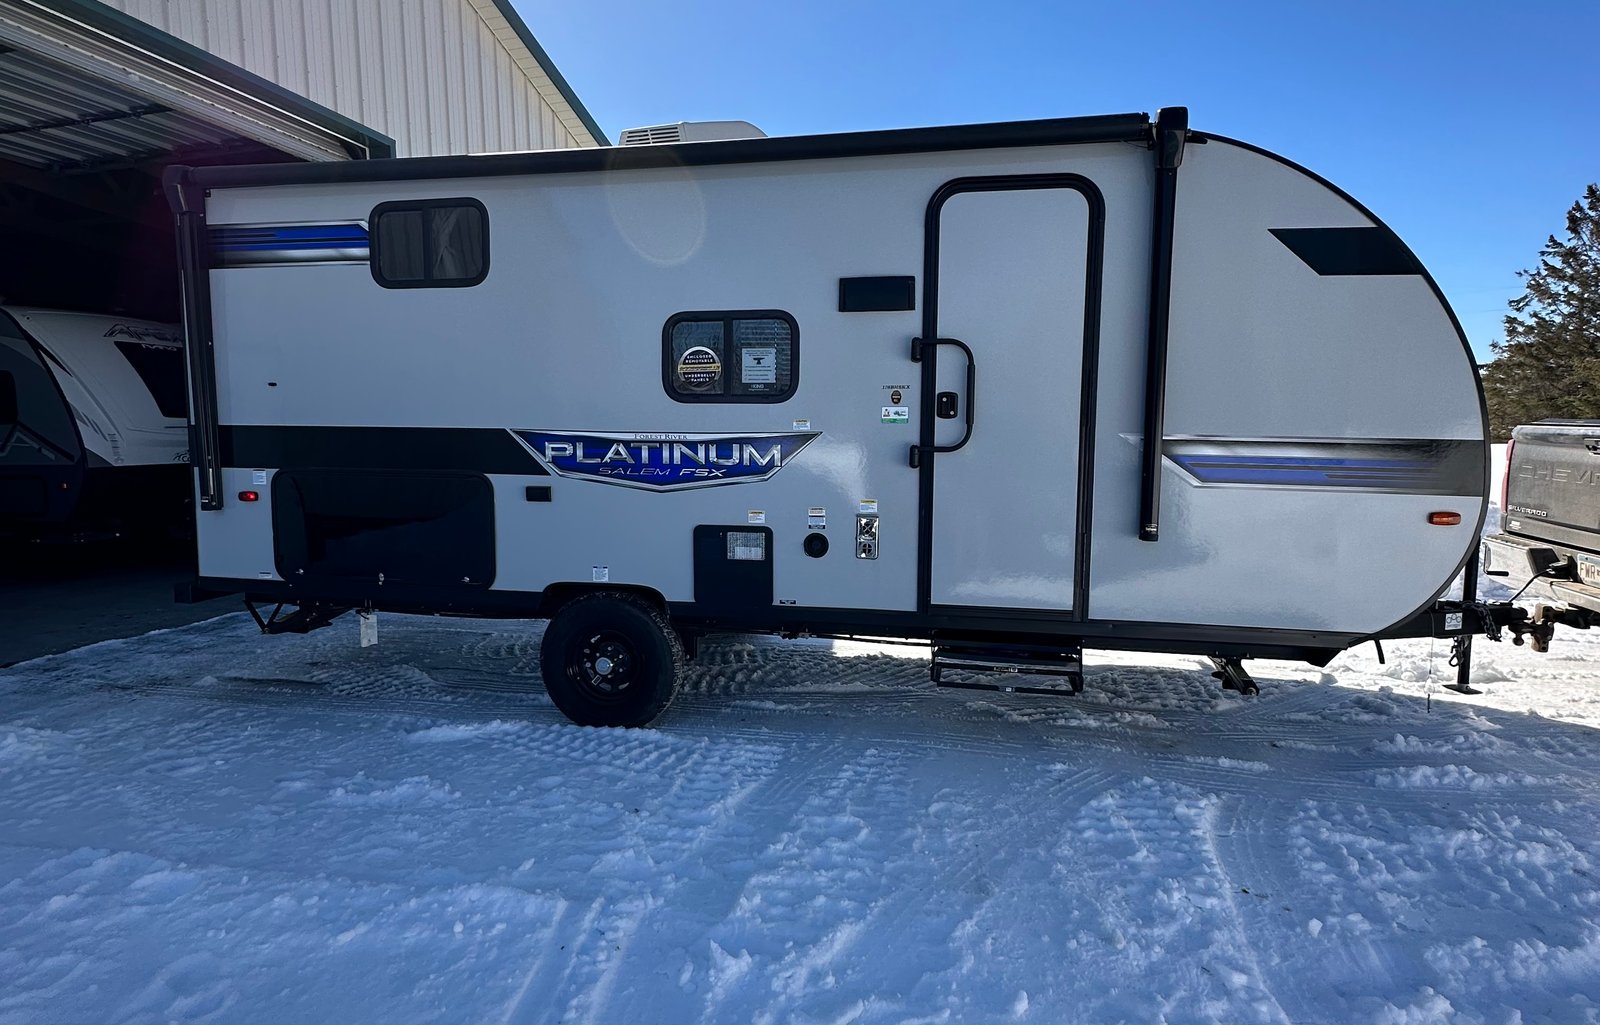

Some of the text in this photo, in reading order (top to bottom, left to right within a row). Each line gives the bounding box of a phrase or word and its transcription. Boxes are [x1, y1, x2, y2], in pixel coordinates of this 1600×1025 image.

[544, 441, 784, 467] PLATINUM
[598, 467, 728, 477] SALEM FSX
[1508, 505, 1547, 517] SILVERADO
